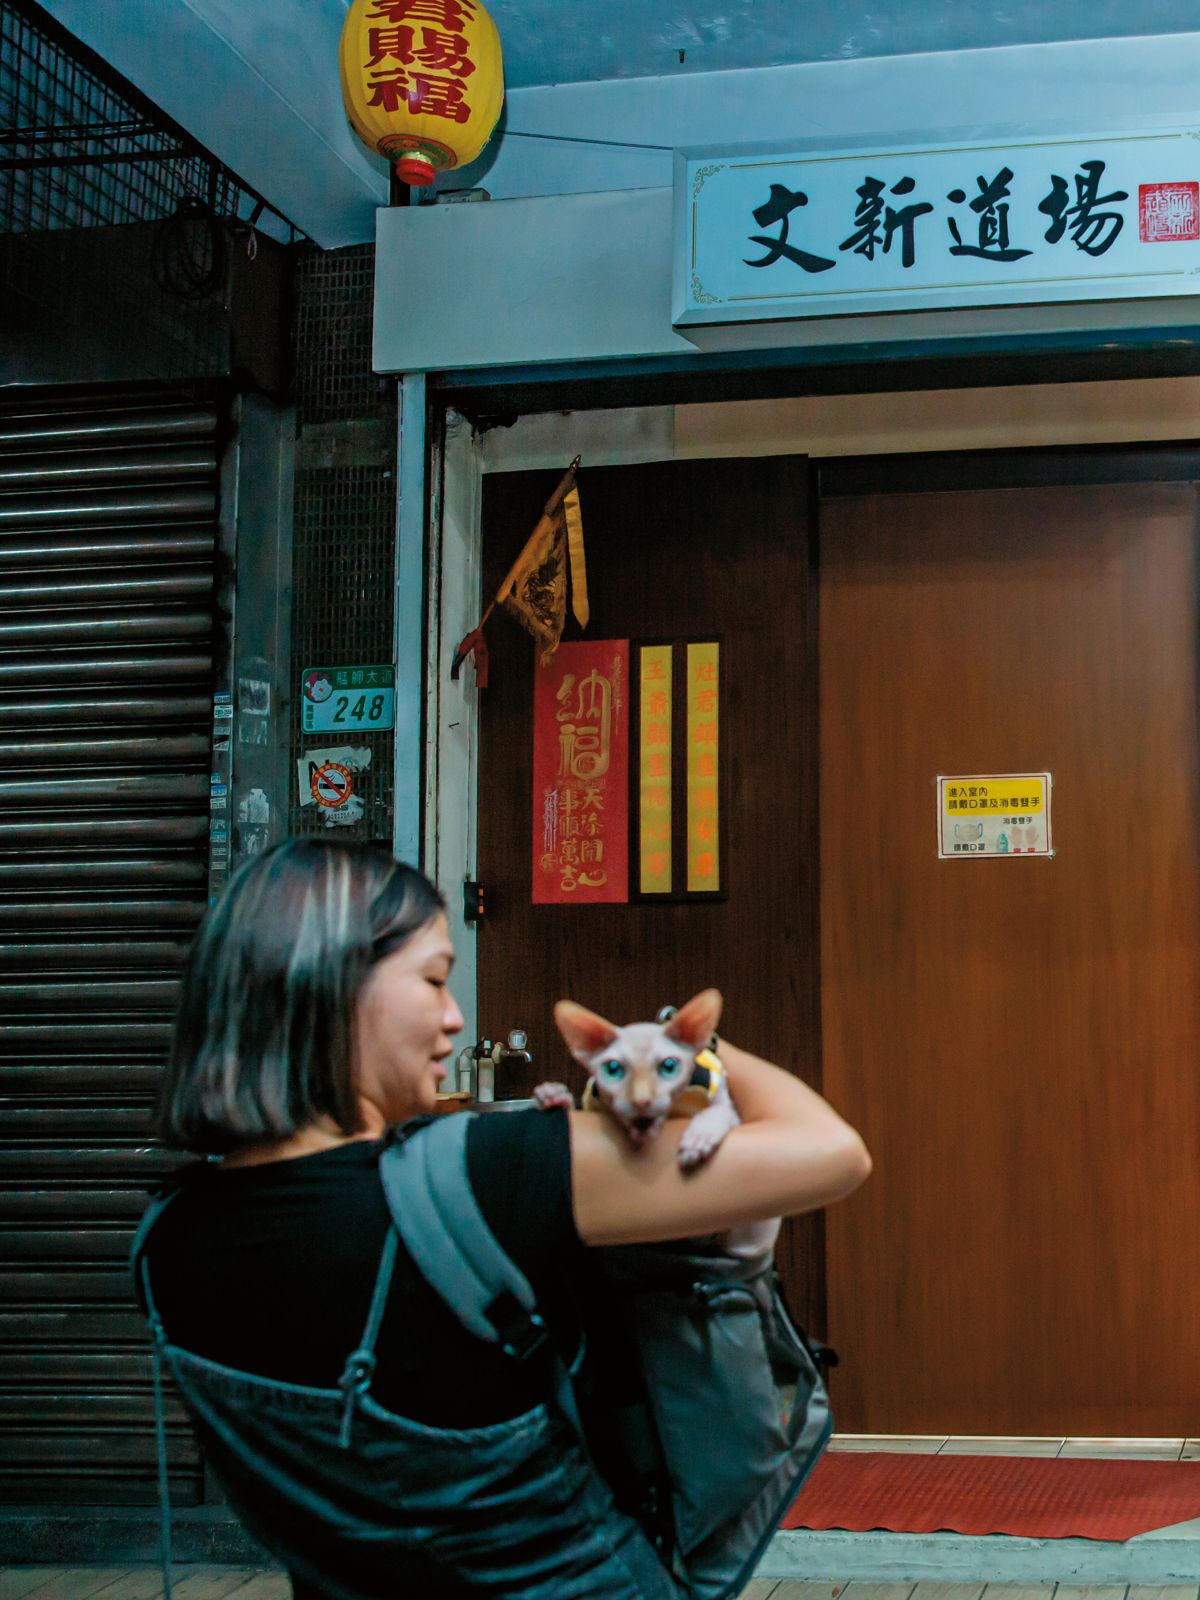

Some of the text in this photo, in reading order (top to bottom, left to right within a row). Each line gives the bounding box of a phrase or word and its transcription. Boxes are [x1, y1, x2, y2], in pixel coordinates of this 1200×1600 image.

[741, 160, 1129, 273] 文新道場
[333, 694, 385, 722] 248
